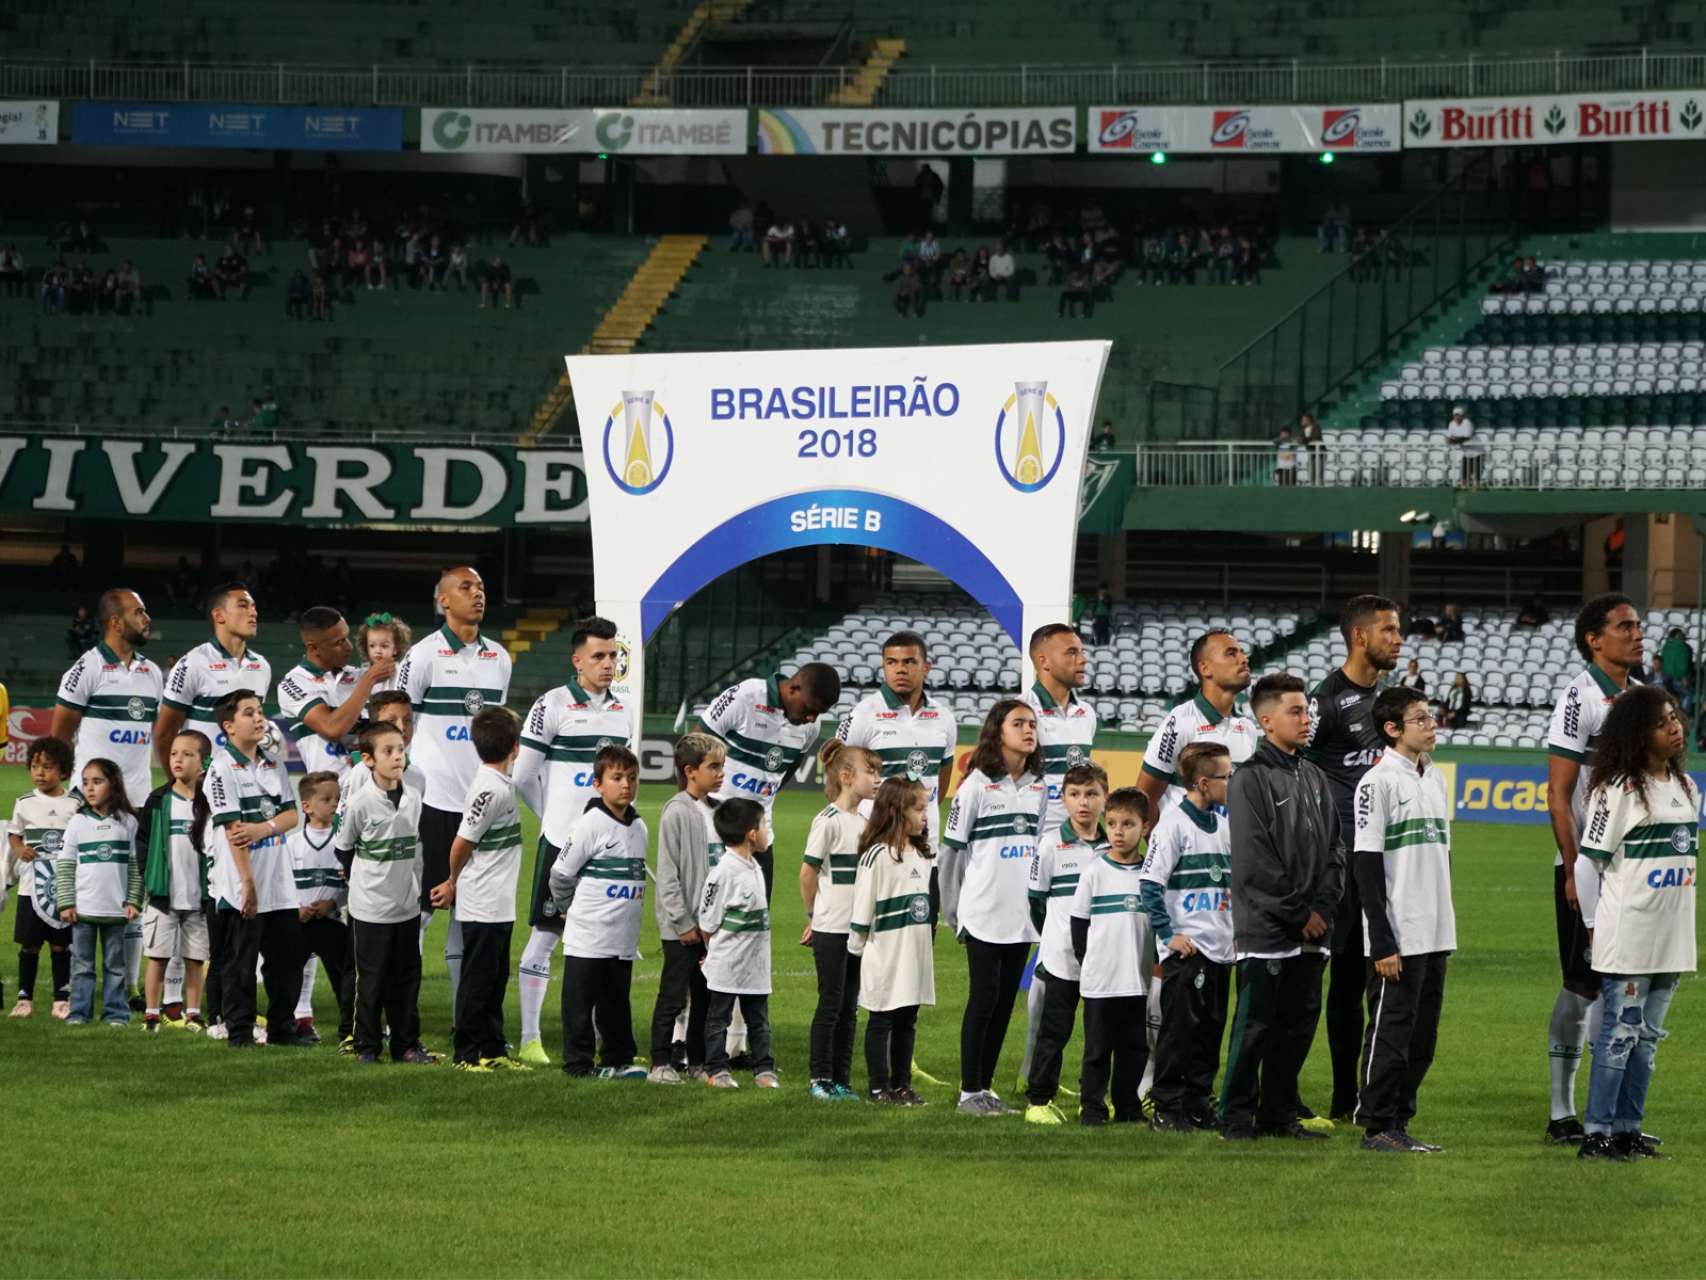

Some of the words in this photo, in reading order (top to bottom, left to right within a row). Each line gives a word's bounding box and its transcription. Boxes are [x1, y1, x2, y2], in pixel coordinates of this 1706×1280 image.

[637, 122, 731, 145] ITAMBÉ
[821, 112, 1075, 151] TECNICÓPIAS
[1441, 106, 1534, 141] Buriti
[1578, 100, 1672, 137] Buriti
[710, 375, 960, 420] BRASILEIRÃO
[797, 429, 878, 458] 2018
[0, 437, 589, 523] IVERDE
[790, 504, 858, 534] SÉRIE
[863, 511, 882, 532] B
[1563, 704, 1572, 738] PRO
[1570, 702, 1582, 740] TORK
[1164, 729, 1179, 764] TORK
[1357, 783, 1371, 816] IRA
[1588, 810, 1600, 842] PRO
[1594, 809, 1611, 845] TORK
[606, 884, 645, 901] CAIX
[1647, 867, 1696, 889] CAIX
[1183, 892, 1232, 913] CAIX
